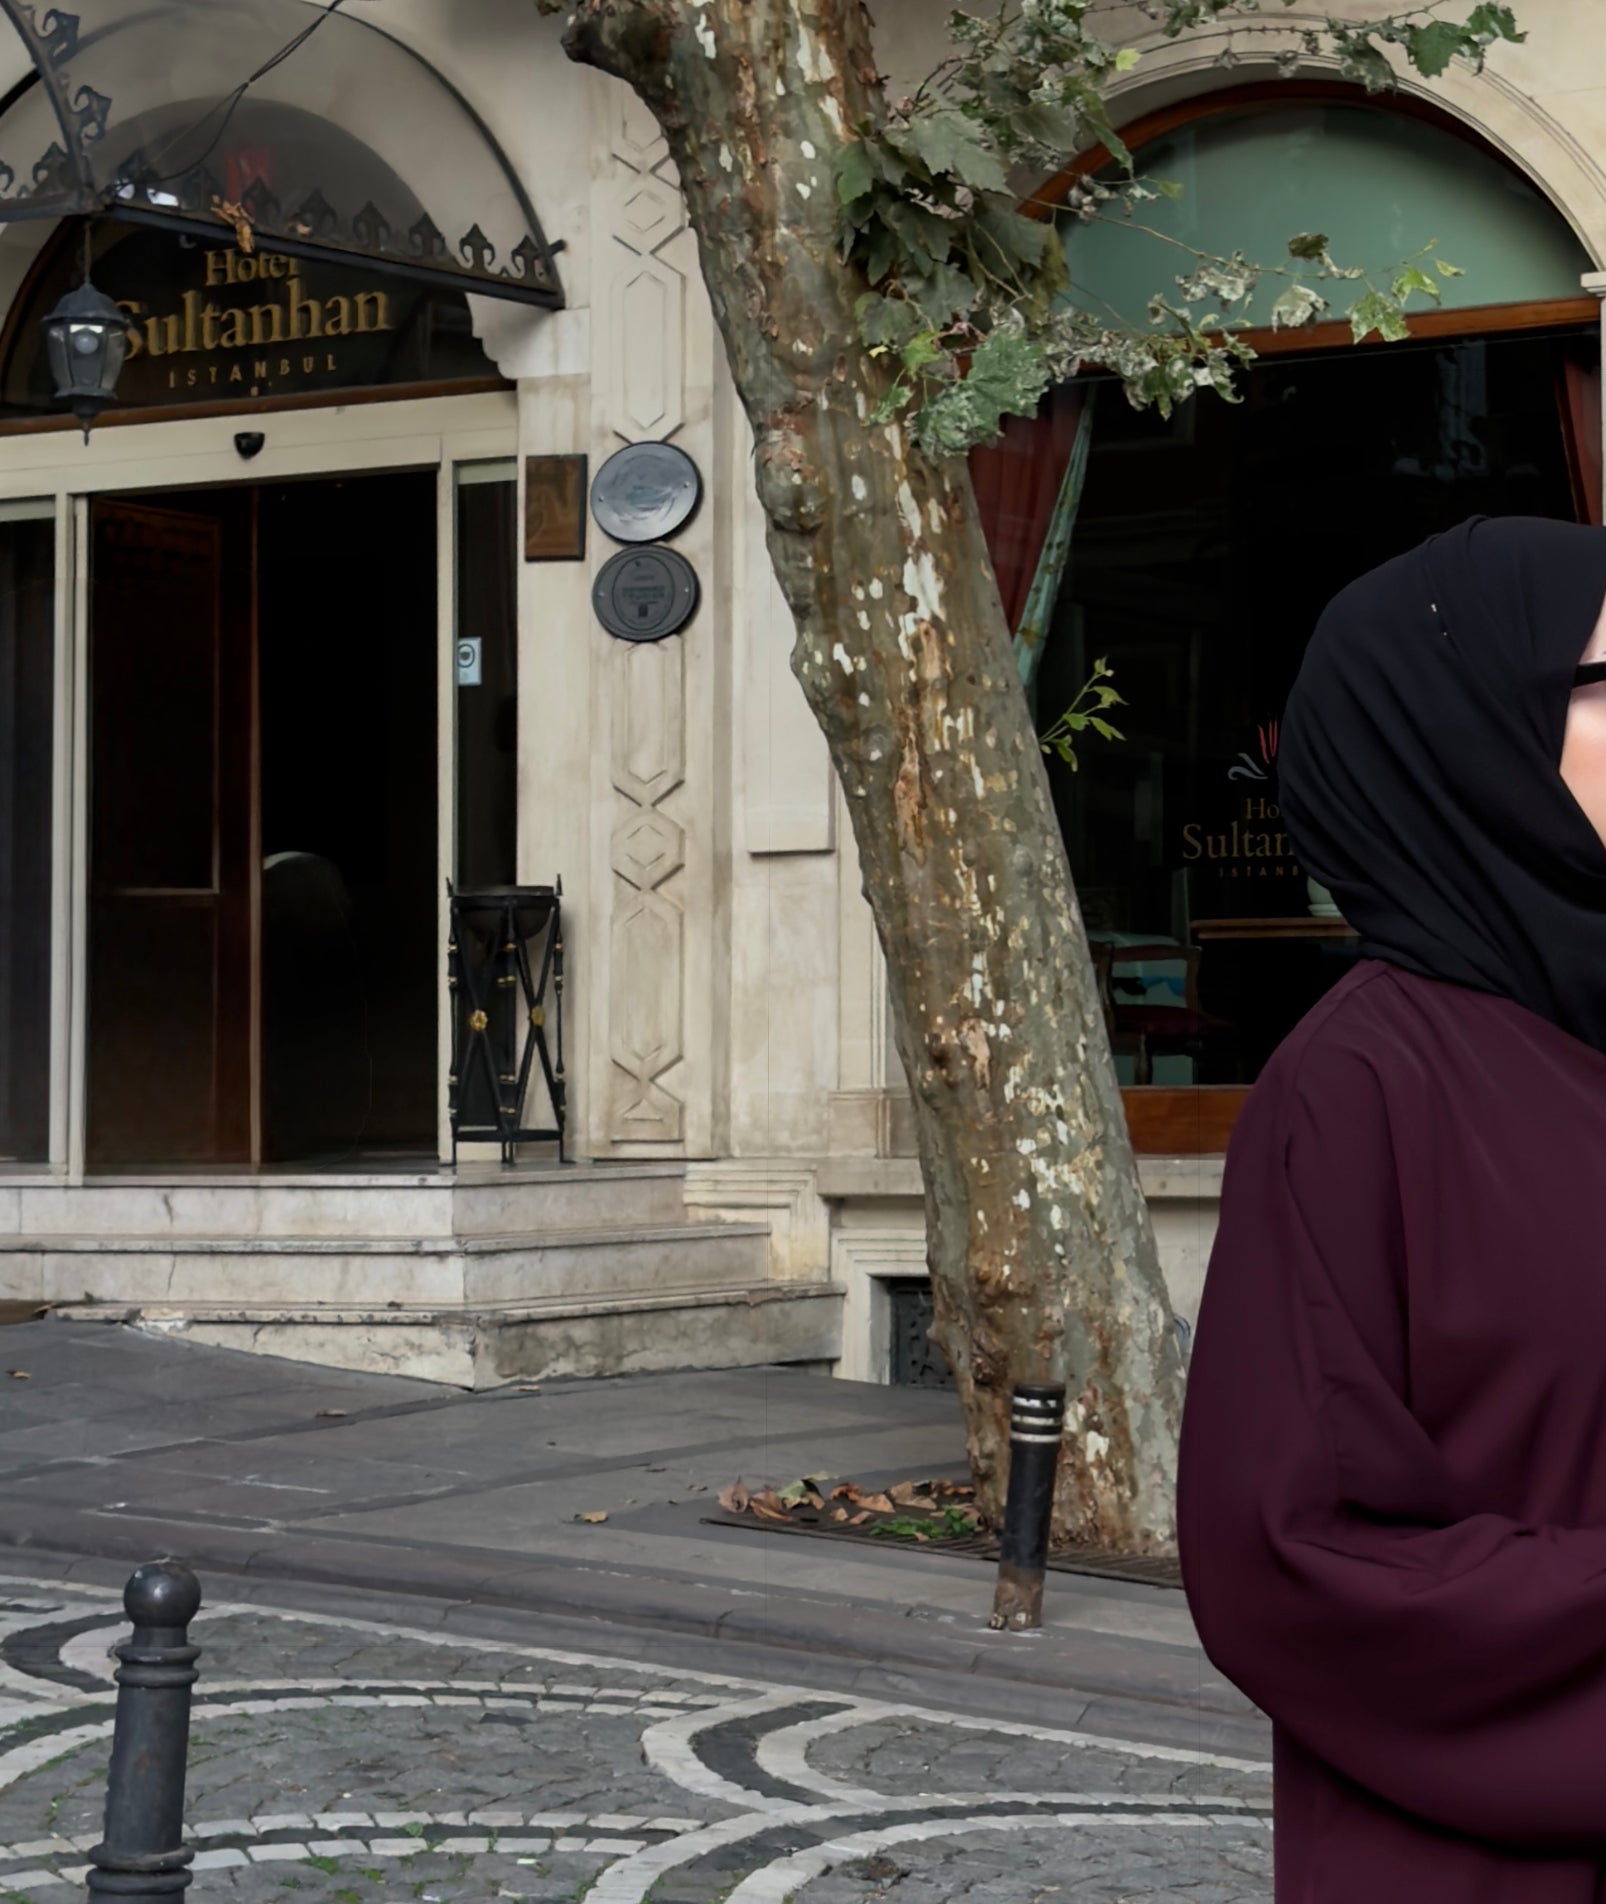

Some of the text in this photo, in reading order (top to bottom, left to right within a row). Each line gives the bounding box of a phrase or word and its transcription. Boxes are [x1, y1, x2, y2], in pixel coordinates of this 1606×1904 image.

[203, 248, 300, 286] Hotel
[115, 278, 394, 360] Sultanhan
[1182, 820, 1296, 860] Sultan
